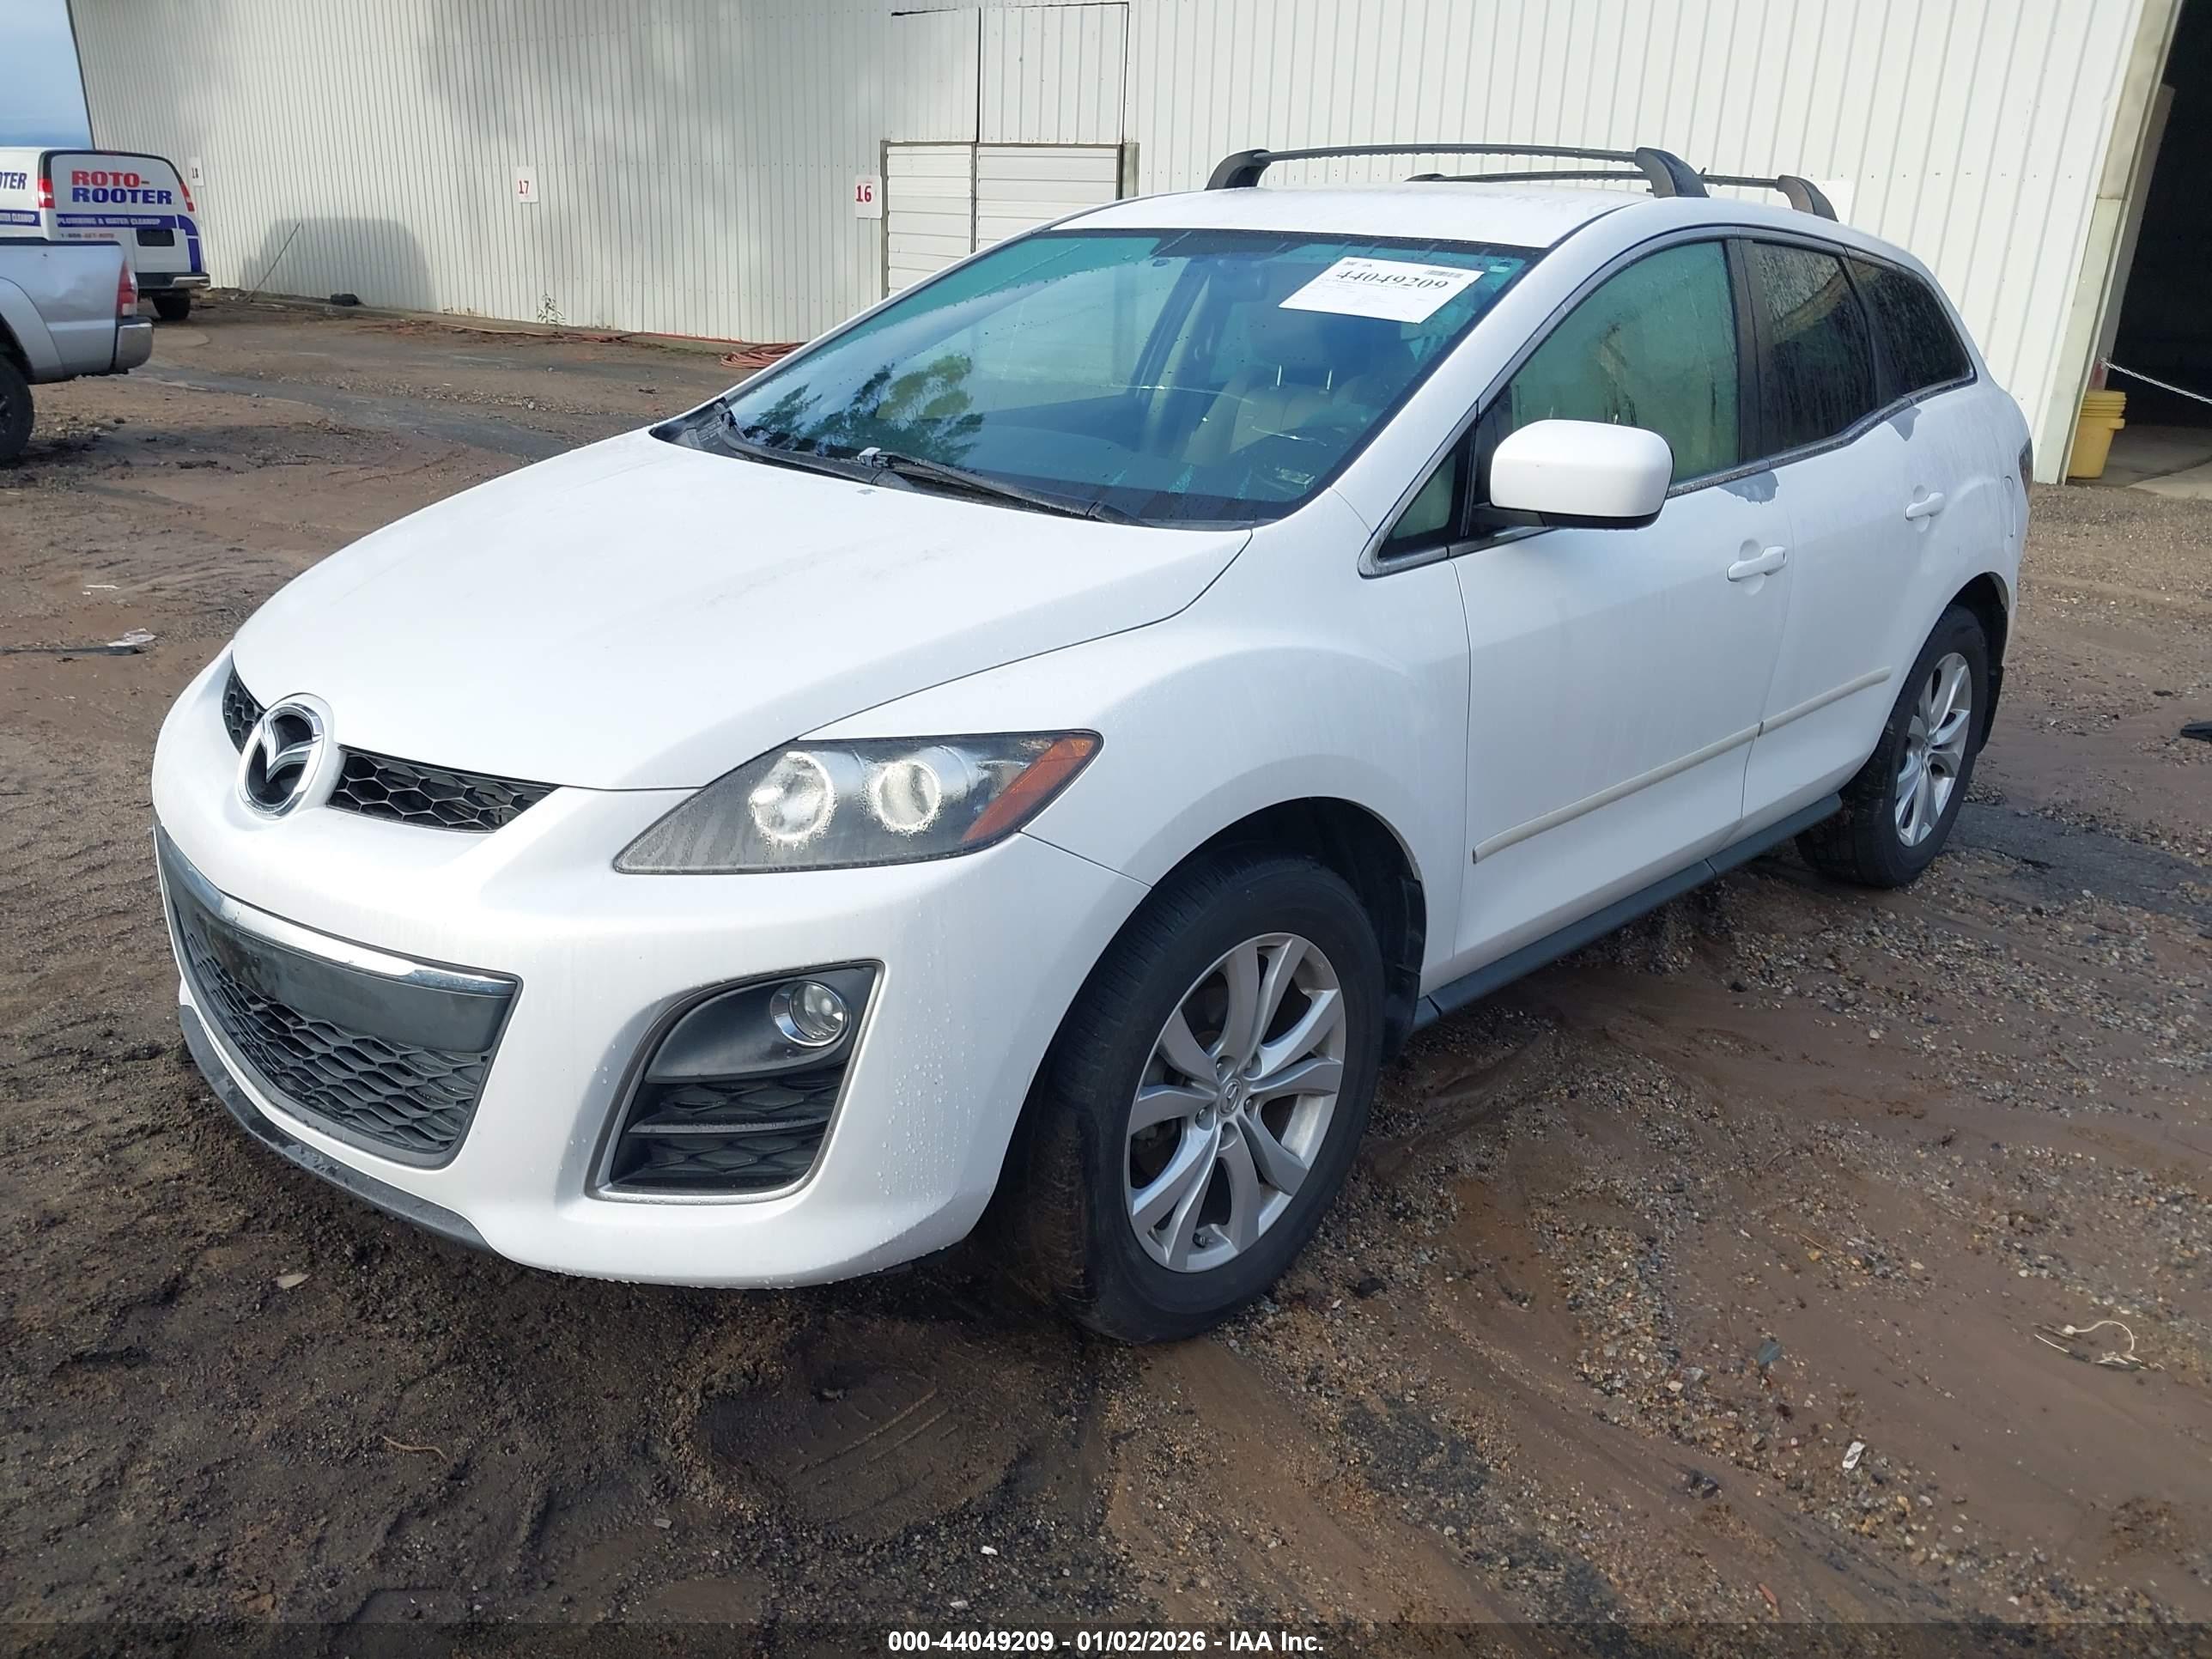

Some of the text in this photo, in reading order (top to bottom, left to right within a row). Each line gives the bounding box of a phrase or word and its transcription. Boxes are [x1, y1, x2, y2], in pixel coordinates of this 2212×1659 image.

[71, 171, 149, 187] ROTO-
[519, 180, 529, 194] 17
[72, 188, 173, 204] ROOTER
[856, 185, 872, 203] 16
[1335, 270, 1449, 289] 44049209
